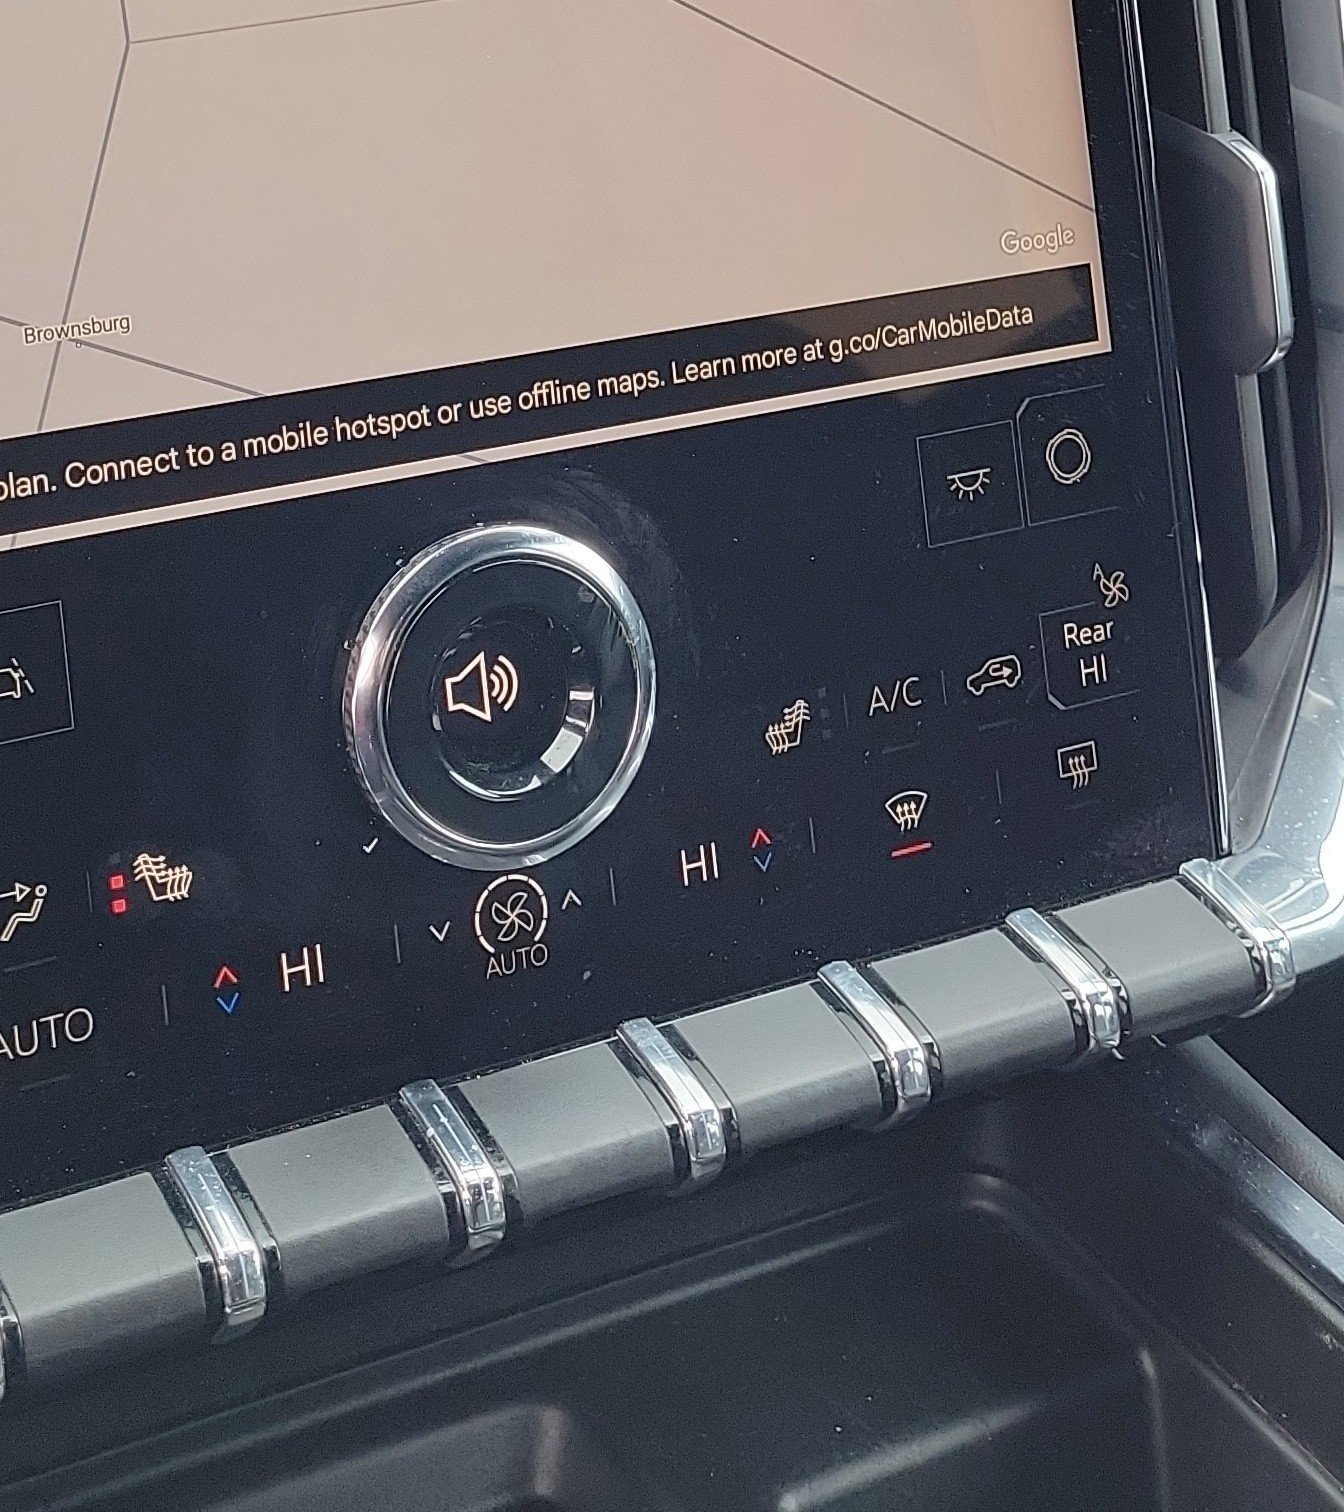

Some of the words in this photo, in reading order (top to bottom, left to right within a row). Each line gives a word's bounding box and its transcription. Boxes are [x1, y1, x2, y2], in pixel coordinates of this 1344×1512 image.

[1000, 223, 1074, 254] Google
[23, 313, 132, 346] Brownsburg
[65, 448, 179, 488] Connect
[186, 442, 213, 467] to
[221, 441, 237, 462] a
[244, 421, 329, 458] mobile
[334, 404, 432, 441] hotspot
[437, 401, 463, 425] or
[469, 392, 512, 419] use
[518, 379, 591, 411] offline
[597, 368, 666, 398] maps.
[671, 354, 735, 385] Learn
[741, 346, 797, 372] more
[803, 338, 824, 361] at
[829, 304, 1034, 363] g.co/CarMobileData
[1063, 621, 1114, 649] Rear
[1080, 653, 1107, 687] HI
[869, 677, 922, 717] A/C
[681, 842, 719, 886] HI
[281, 943, 325, 991] HI
[486, 943, 548, 979] AUTO
